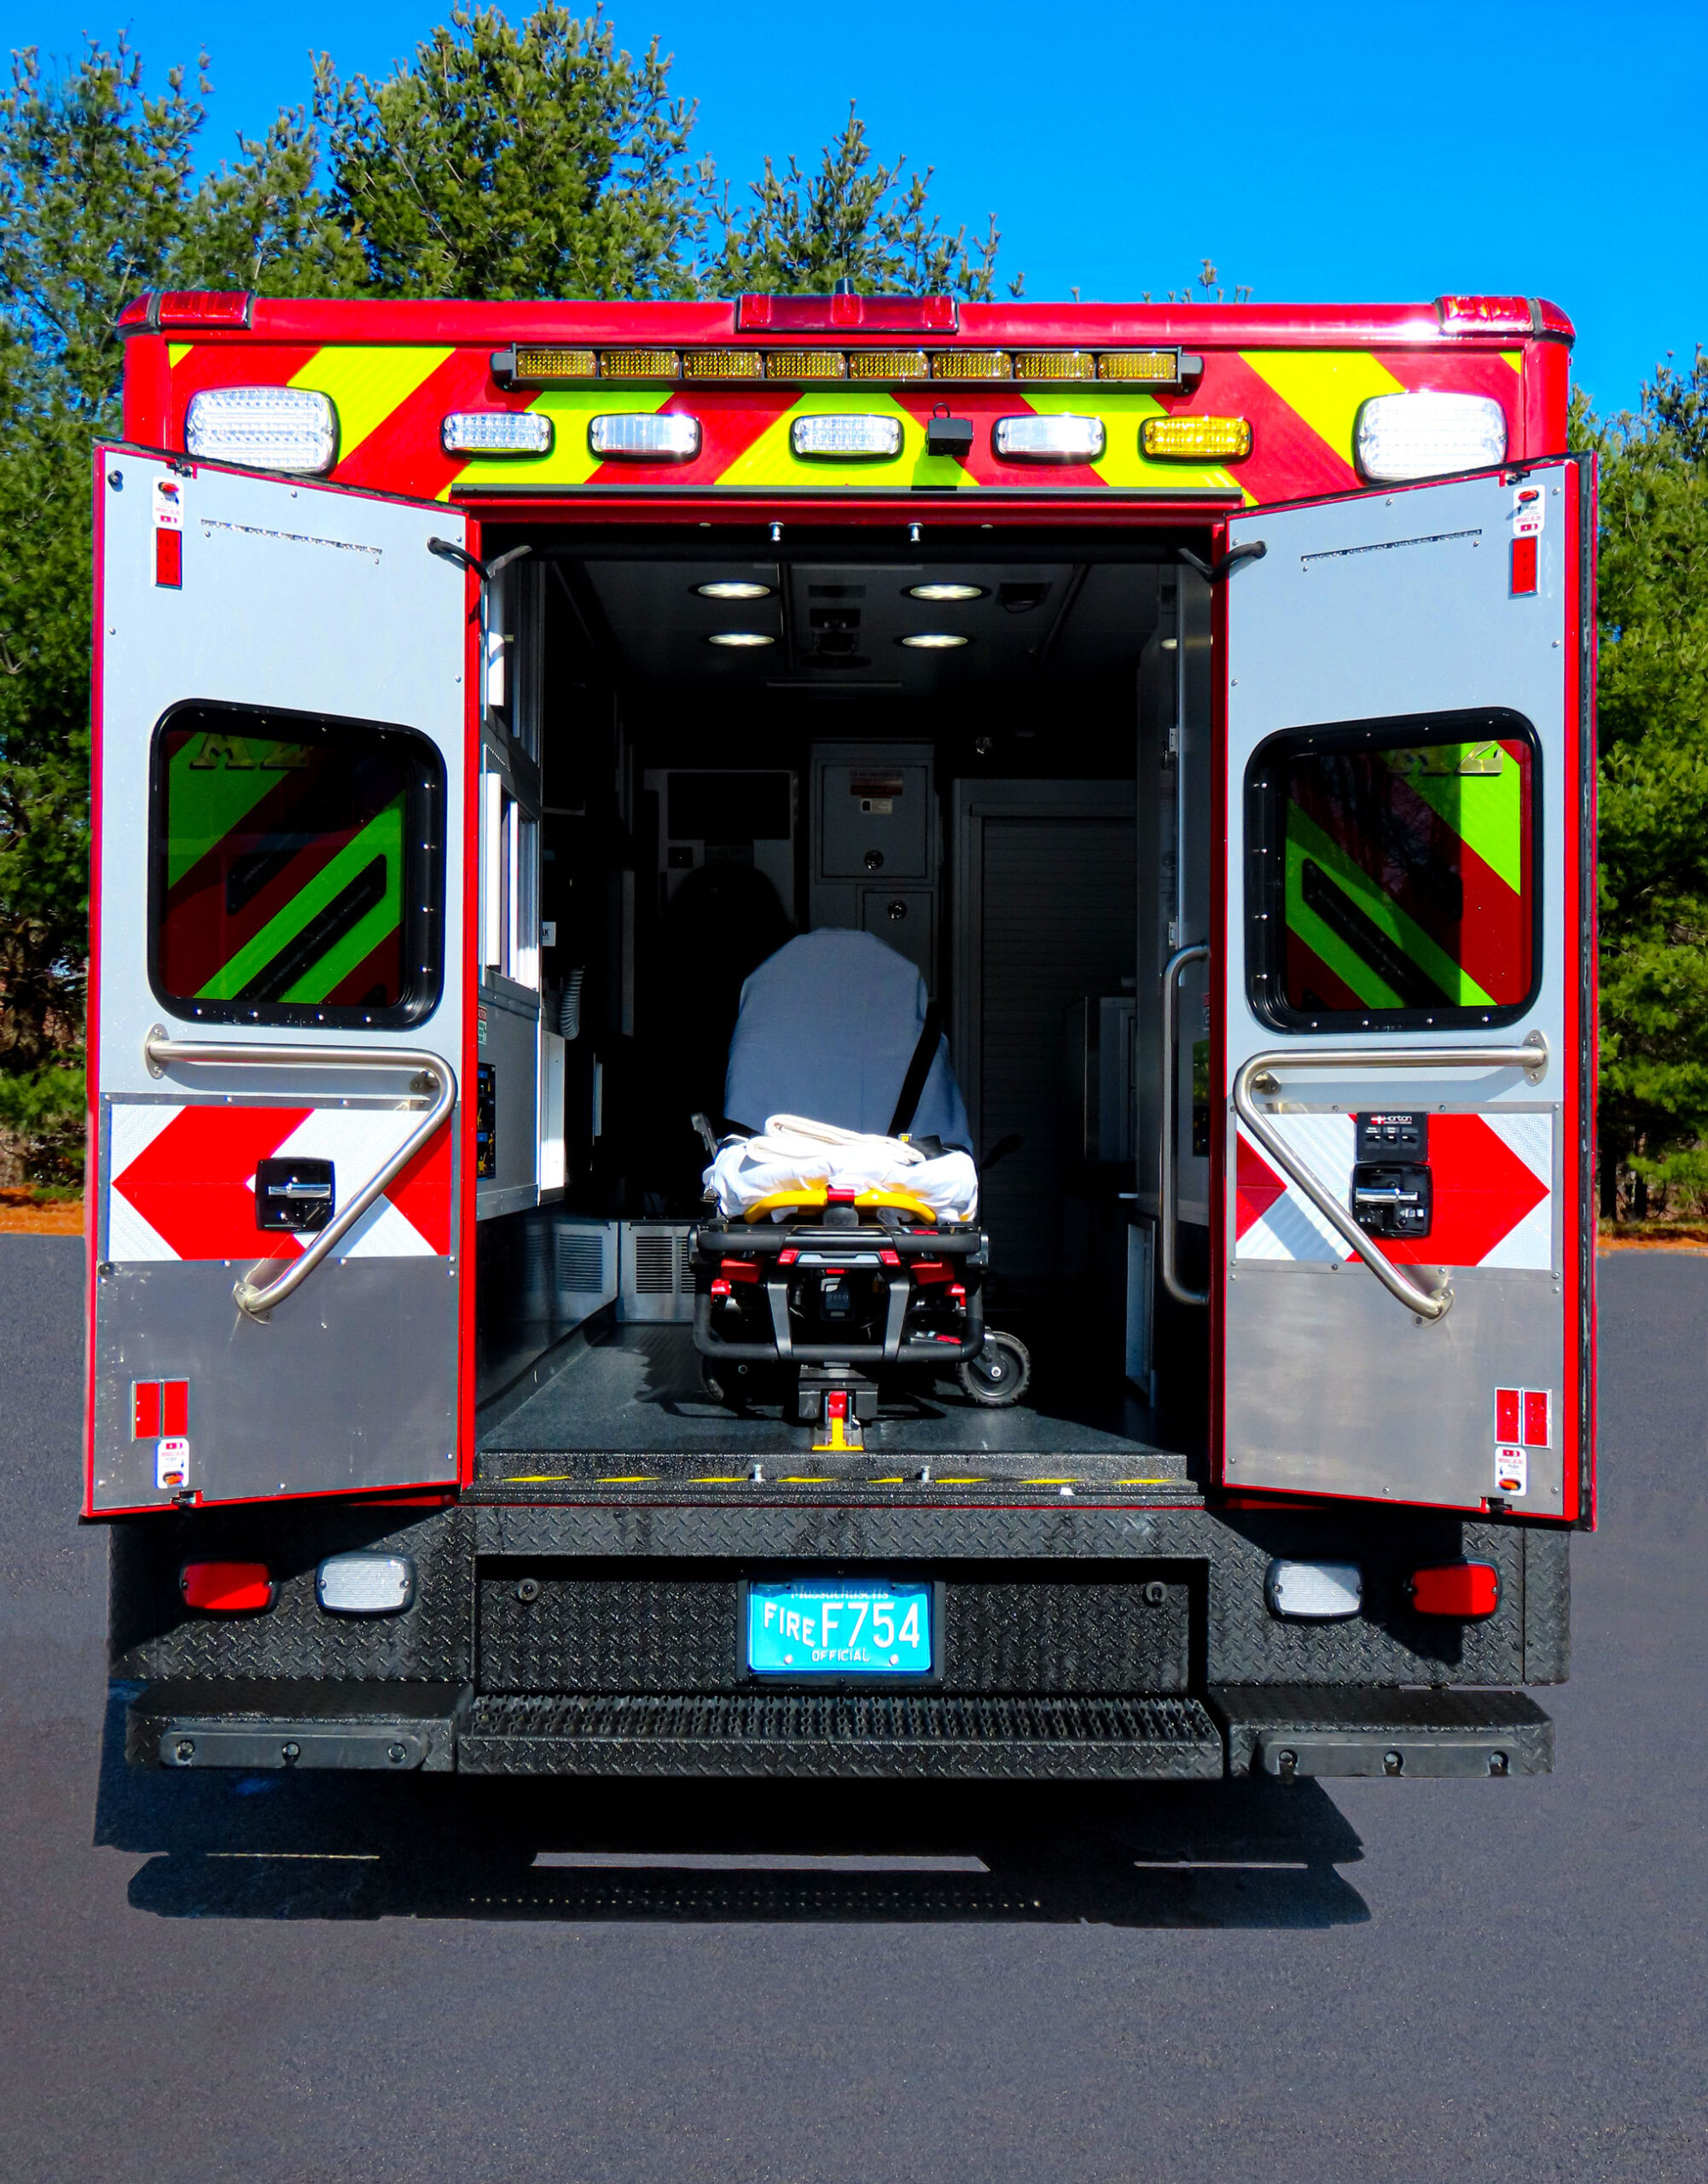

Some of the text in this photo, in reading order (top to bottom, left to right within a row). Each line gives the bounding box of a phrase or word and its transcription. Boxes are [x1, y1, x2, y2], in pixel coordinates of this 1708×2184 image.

[791, 1584, 889, 1600] Massachusetts
[764, 1601, 921, 1649] FIRE F754
[811, 1647, 871, 1663] OFFICIAL
